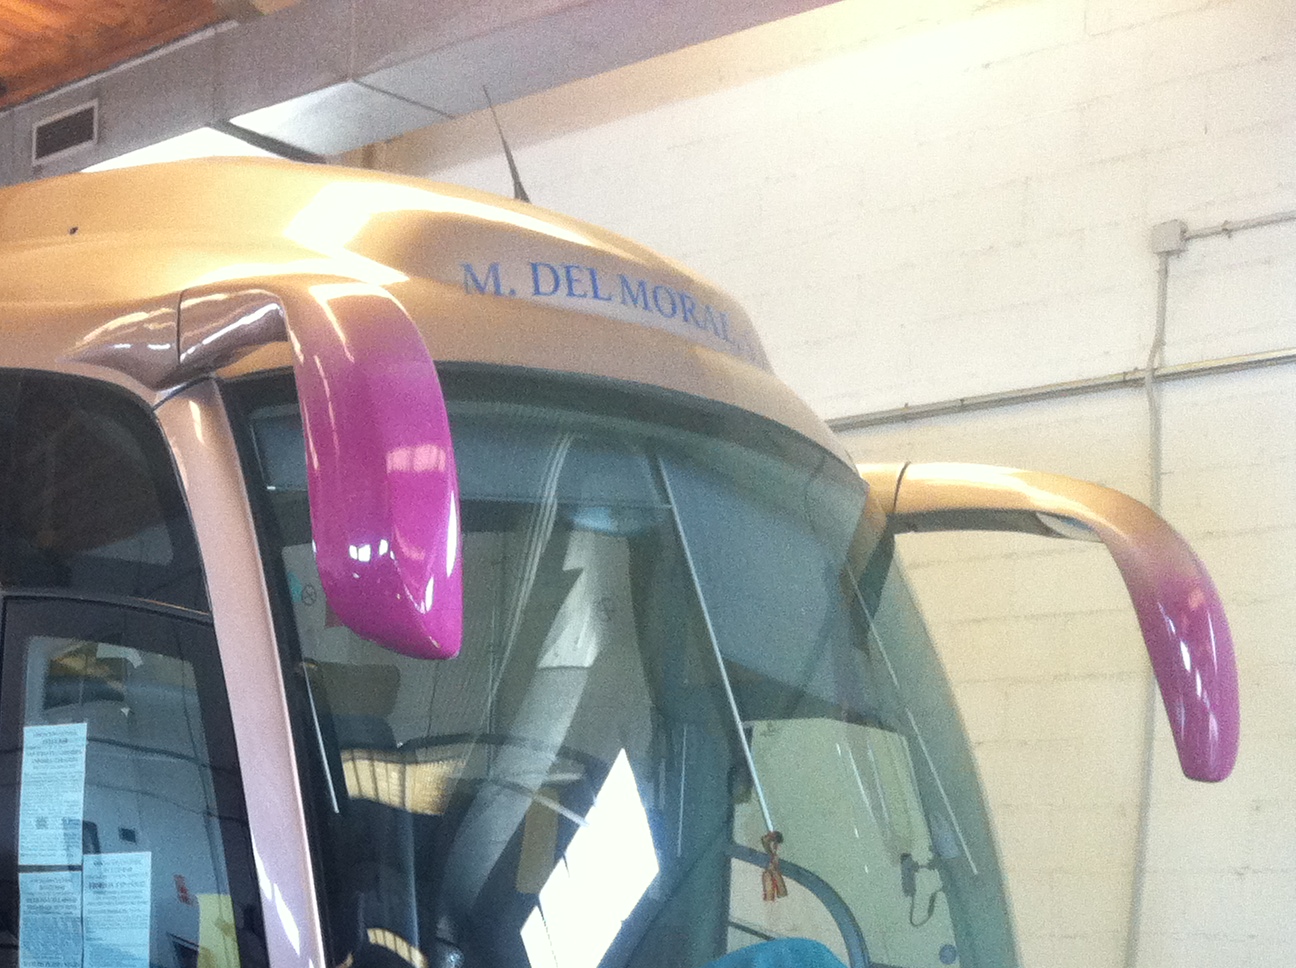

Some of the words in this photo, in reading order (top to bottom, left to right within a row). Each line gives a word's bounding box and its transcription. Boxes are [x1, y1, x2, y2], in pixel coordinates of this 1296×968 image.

[462, 261, 517, 297] M.
[530, 261, 613, 301] DEL
[618, 273, 739, 344] MORAL
